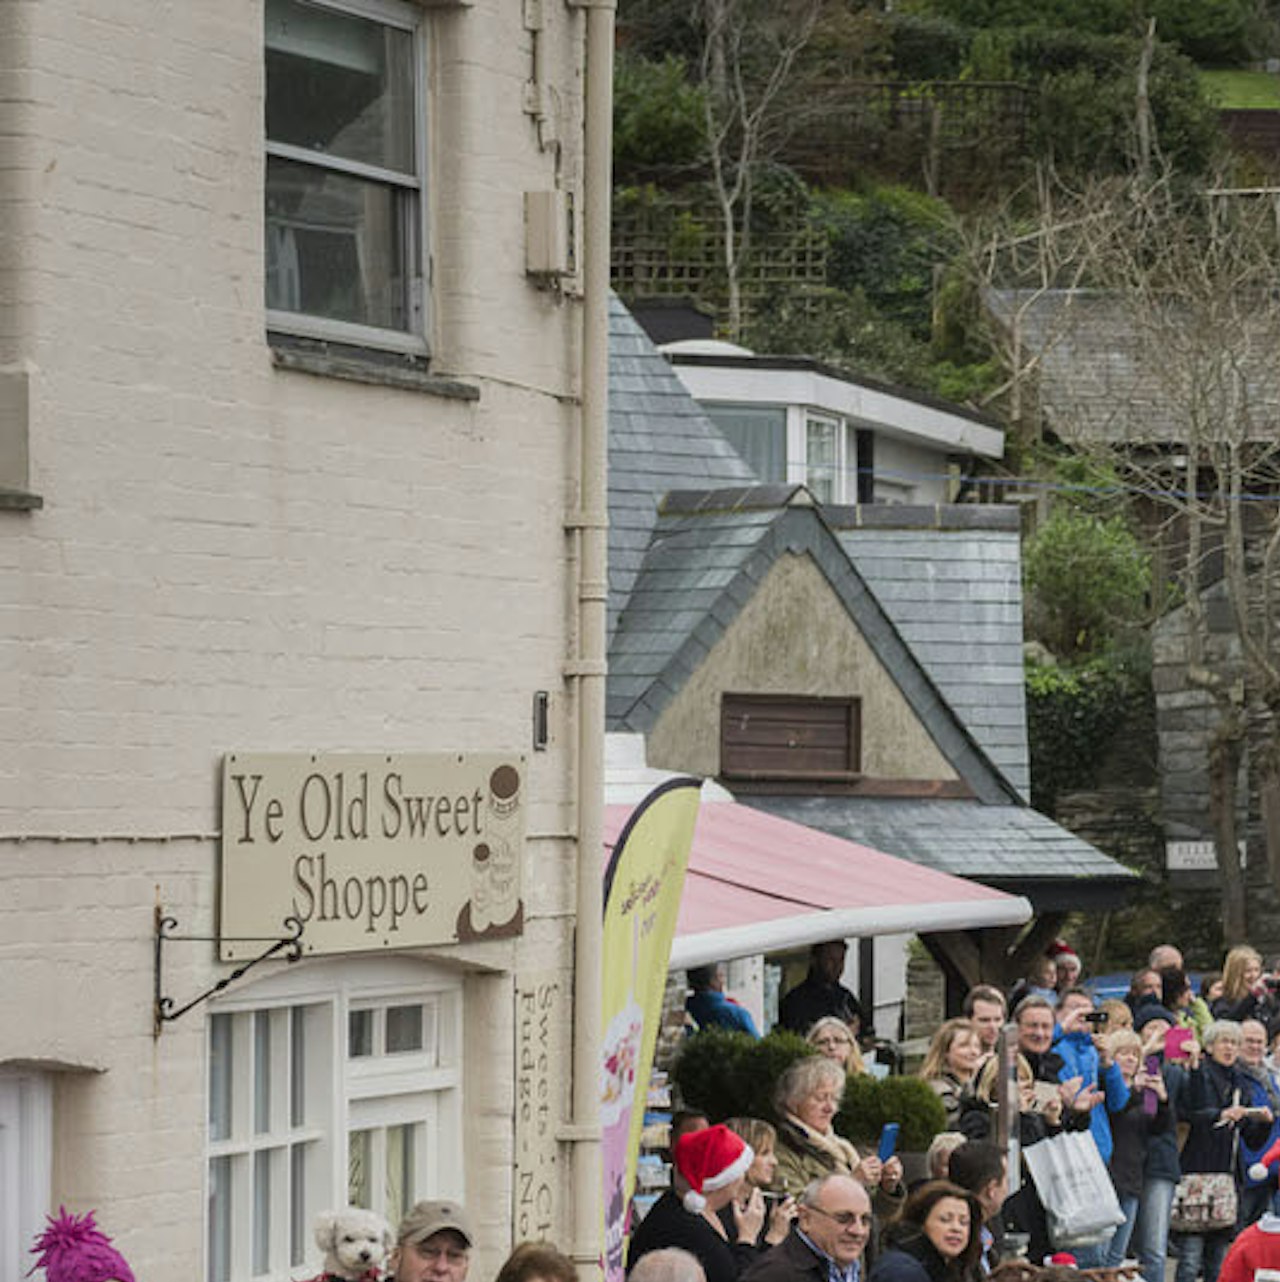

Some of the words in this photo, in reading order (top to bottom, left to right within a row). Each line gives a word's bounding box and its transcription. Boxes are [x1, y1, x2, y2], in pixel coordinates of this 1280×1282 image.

[231, 774, 285, 844] Ye
[299, 771, 368, 842] Old
[381, 772, 483, 838] Sweet
[292, 853, 430, 932] Shoppe
[518, 992, 536, 1122] Fudge
[536, 982, 552, 1138] Sweets
